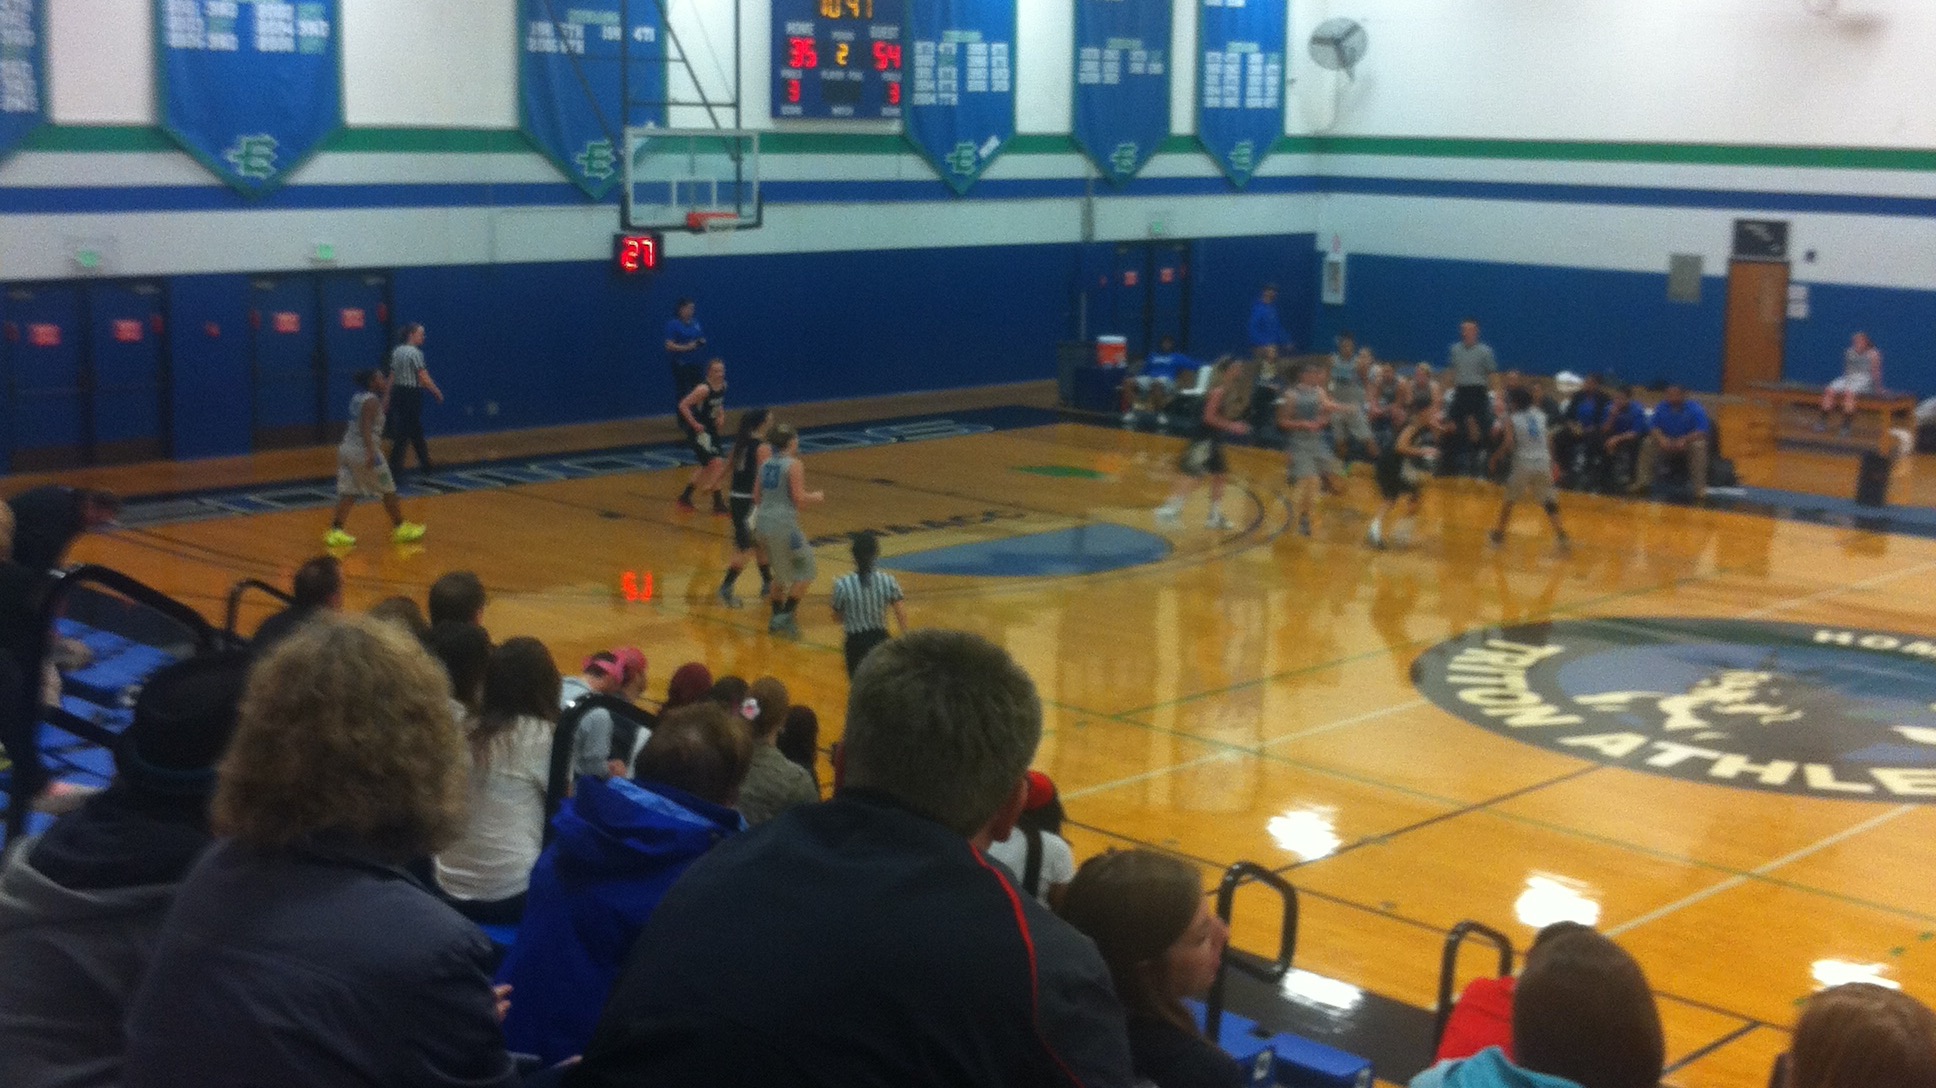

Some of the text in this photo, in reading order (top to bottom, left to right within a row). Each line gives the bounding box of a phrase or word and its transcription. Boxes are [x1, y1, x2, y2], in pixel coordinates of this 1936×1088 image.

[788, 37, 817, 69] 35
[836, 42, 849, 67] 2
[872, 41, 901, 71] 54
[787, 80, 800, 103] 3
[889, 82, 901, 106] 3
[622, 238, 655, 271] 27
[1447, 639, 1584, 728] TRITON
